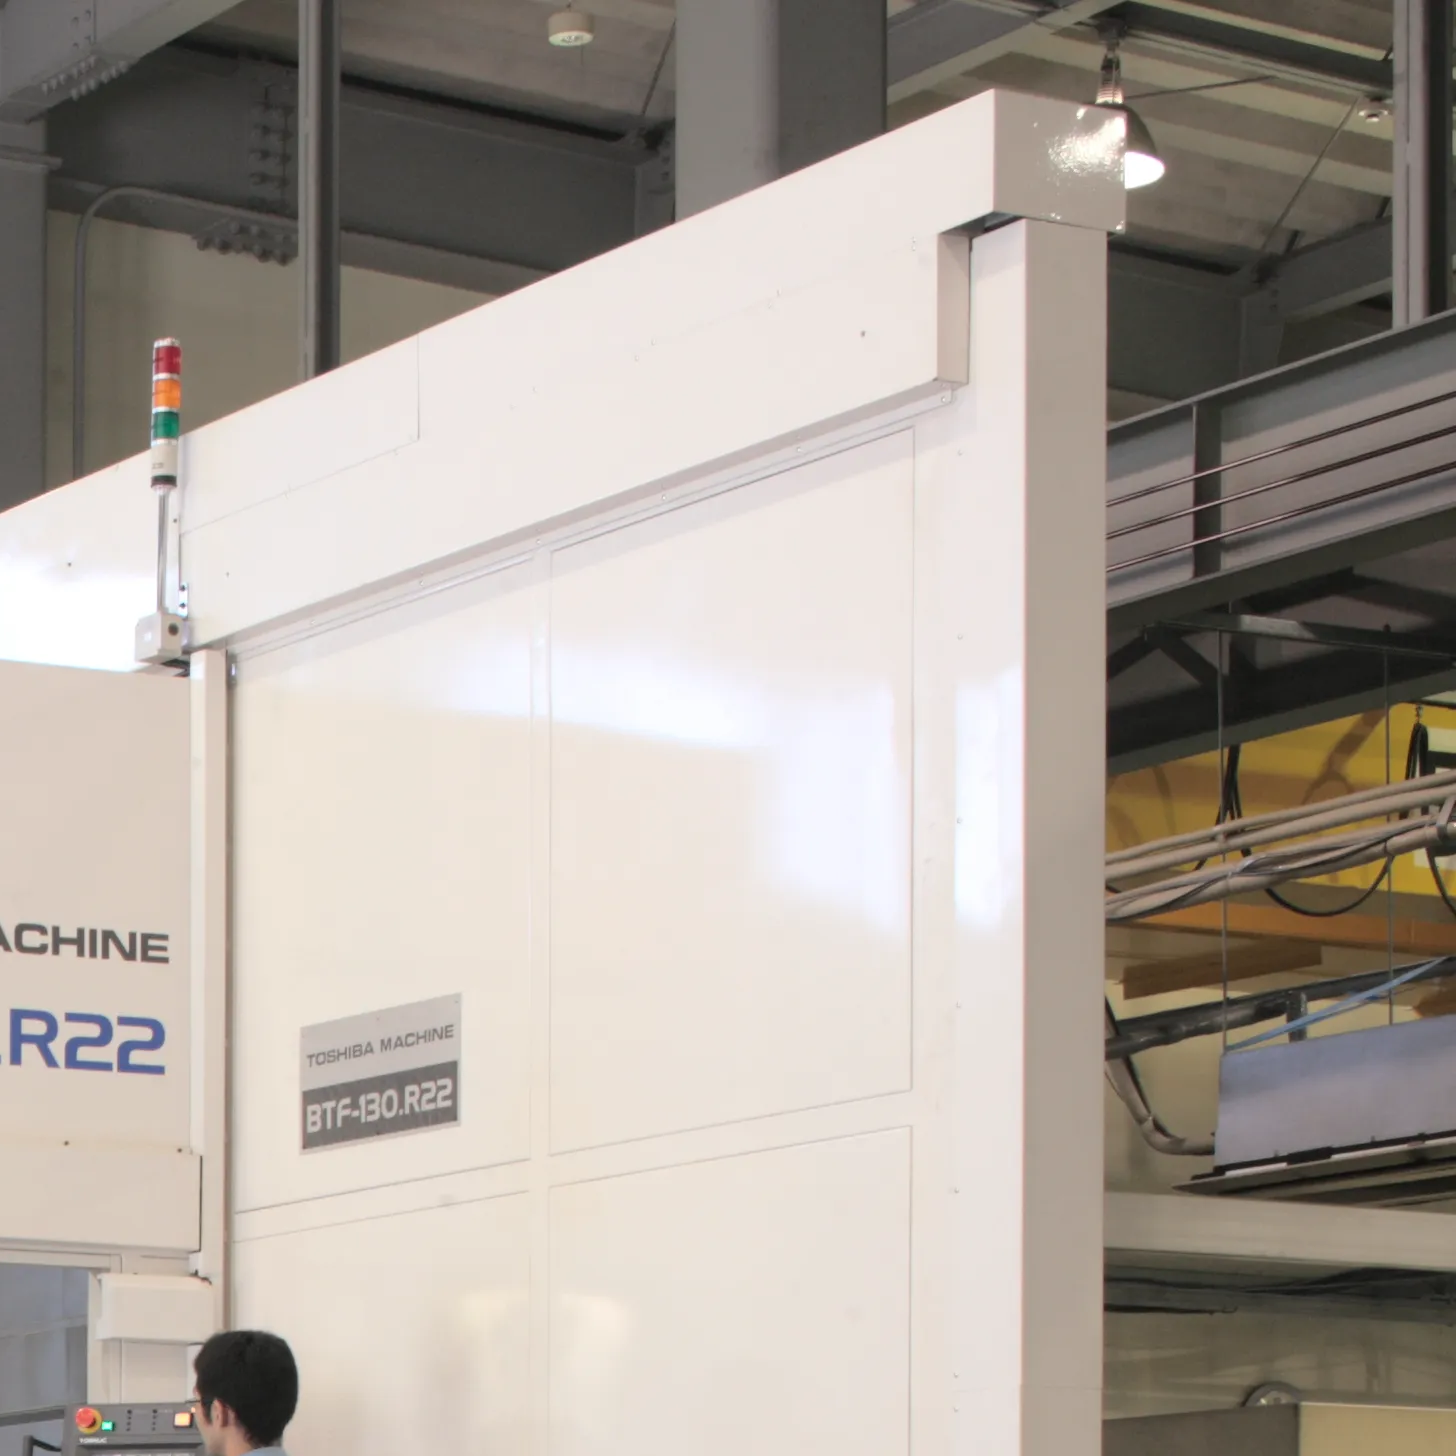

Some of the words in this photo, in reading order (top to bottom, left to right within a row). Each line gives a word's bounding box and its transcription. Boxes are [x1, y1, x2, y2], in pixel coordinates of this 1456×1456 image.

[306, 1041, 374, 1068] TOSHIBA
[380, 1024, 455, 1053] MACHINE
[306, 1077, 452, 1134] BTF-130.R22
